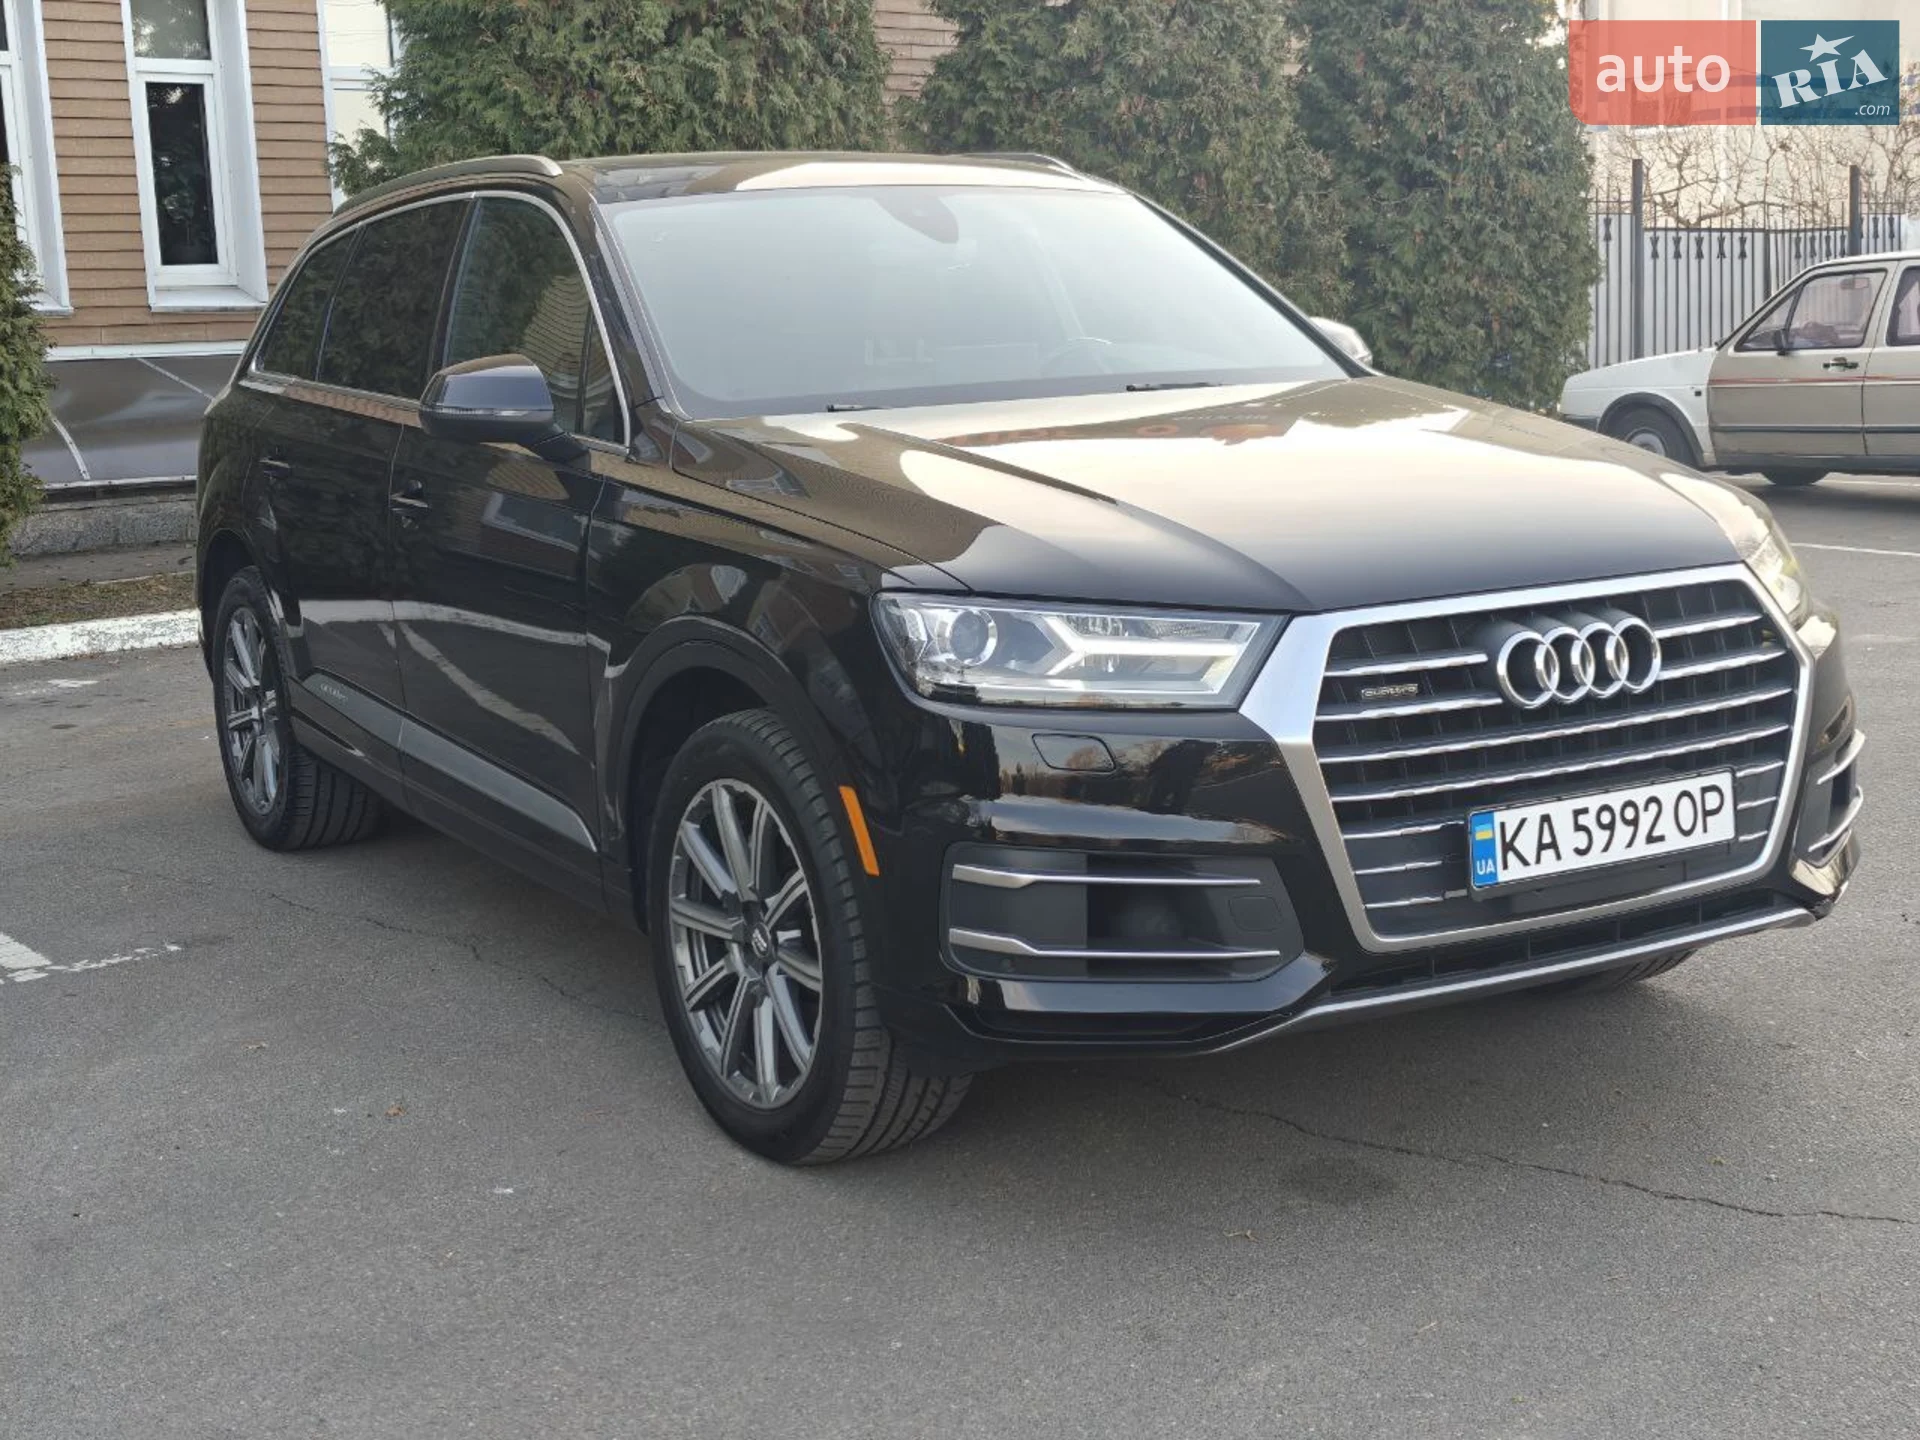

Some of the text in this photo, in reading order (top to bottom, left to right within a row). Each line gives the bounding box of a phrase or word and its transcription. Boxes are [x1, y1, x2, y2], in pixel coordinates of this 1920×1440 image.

[1499, 784, 1725, 870] KA 5992 OP
[1476, 860, 1495, 875] UA
